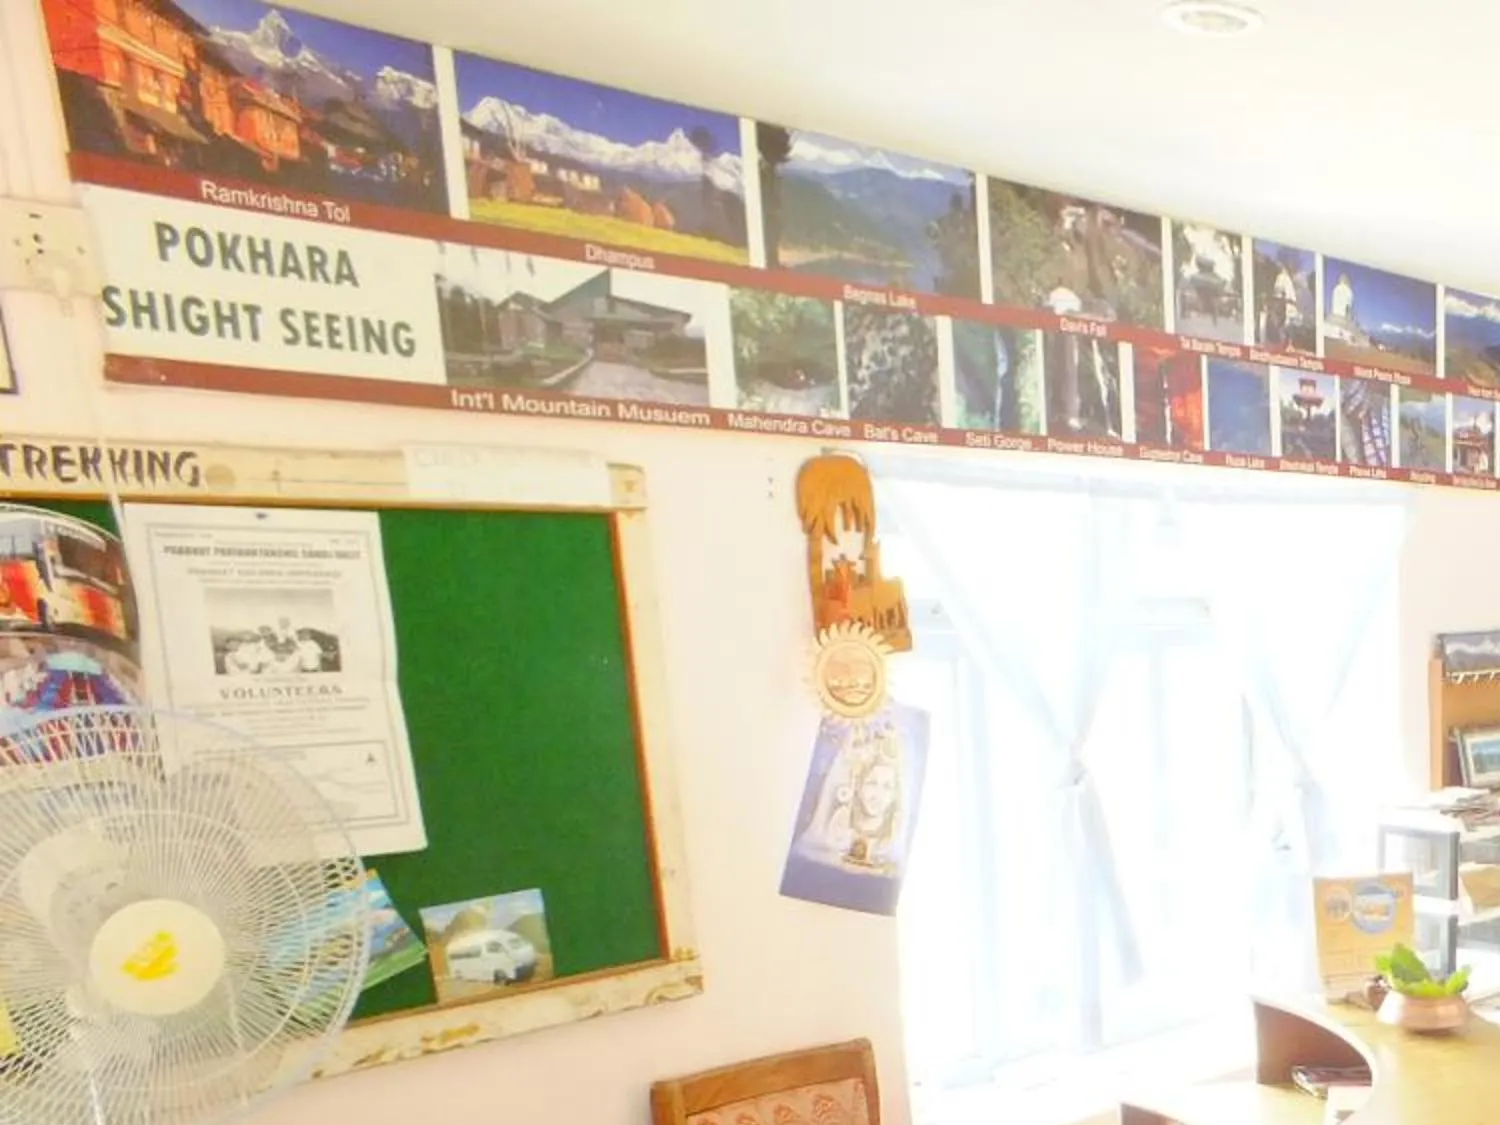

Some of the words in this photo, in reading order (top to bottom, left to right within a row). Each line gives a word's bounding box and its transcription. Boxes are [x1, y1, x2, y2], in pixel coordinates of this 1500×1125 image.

[201, 180, 318, 217] Ramkrishna
[322, 201, 350, 223] Tol
[154, 221, 360, 288] POKHARA
[584, 243, 656, 270] Dhampus
[102, 285, 262, 342] SHIGHT
[280, 307, 416, 358] SEEING
[451, 388, 494, 410] Int'l
[503, 393, 611, 417] Mountain
[618, 403, 711, 426] Musuem
[728, 412, 808, 433] Mahendra
[812, 419, 851, 438] Cave
[0, 443, 200, 487] TREKKING
[219, 685, 343, 700] VOLUNTEERS
